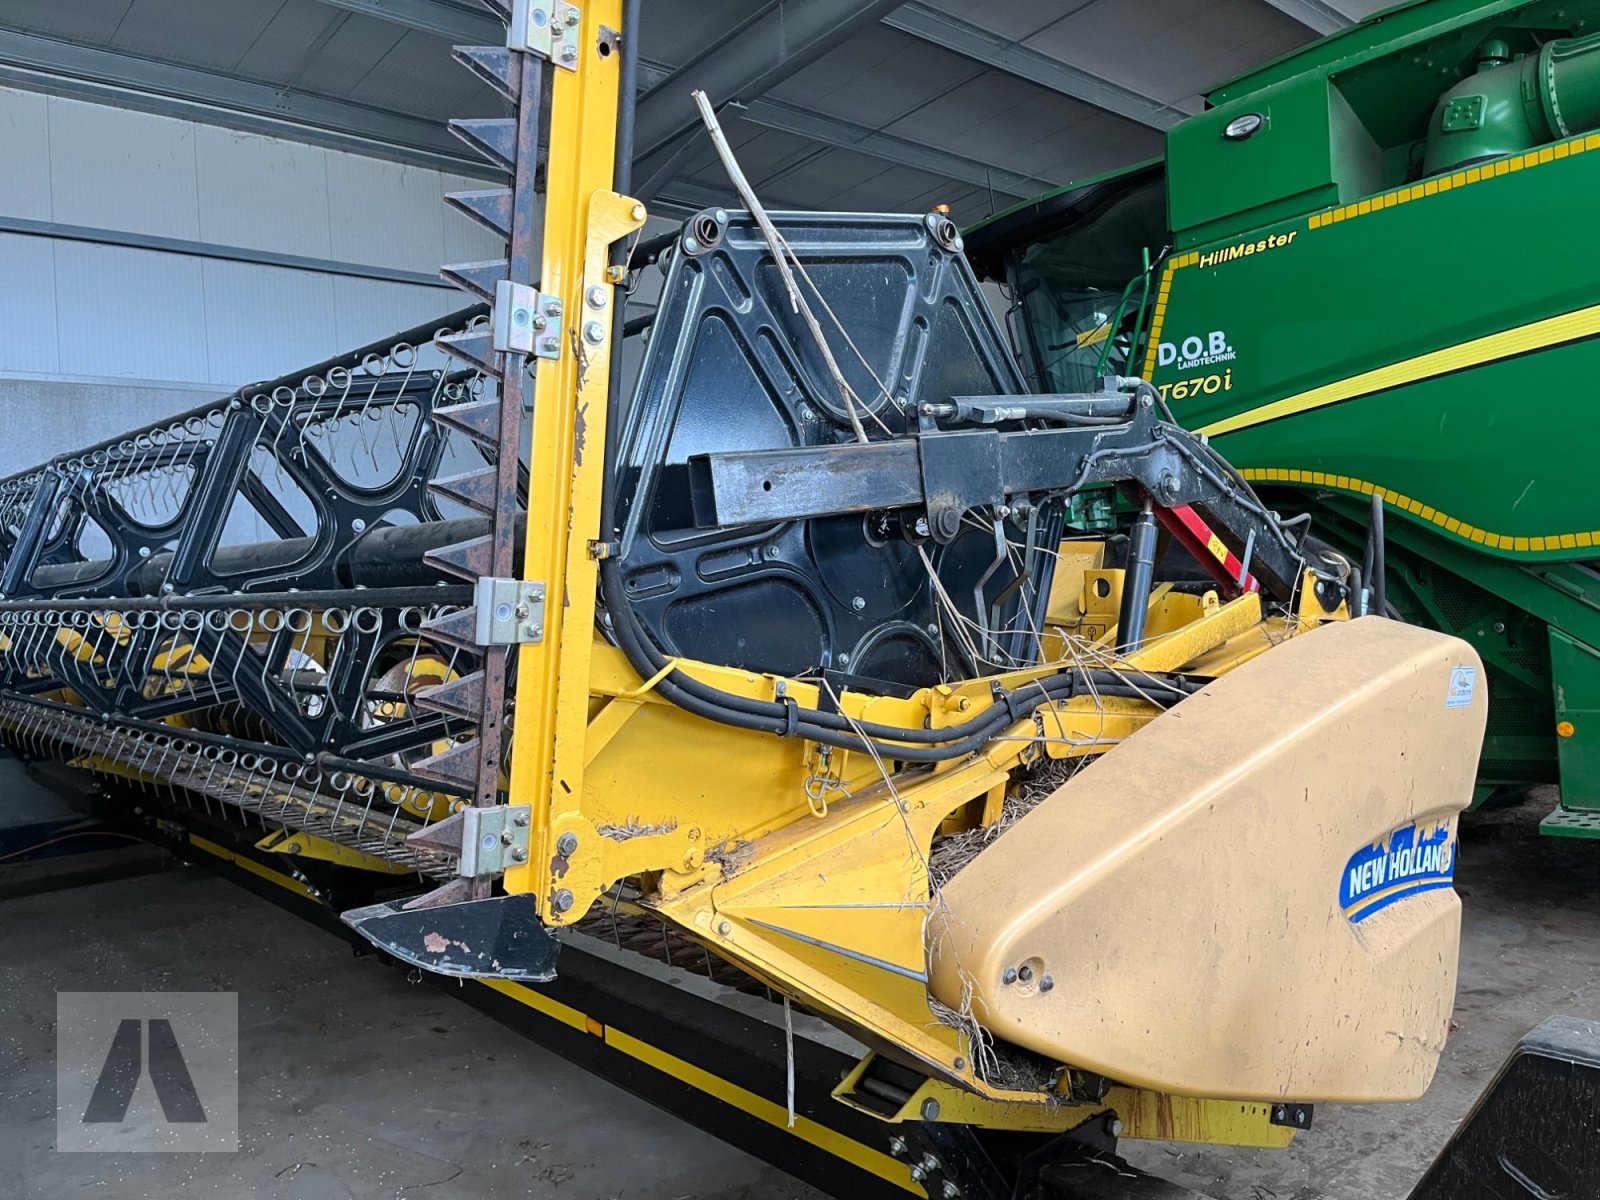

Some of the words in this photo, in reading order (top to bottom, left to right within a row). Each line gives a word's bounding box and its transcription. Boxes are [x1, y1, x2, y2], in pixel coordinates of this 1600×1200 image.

[1199, 231, 1297, 269] HillMaster
[1158, 330, 1233, 366] D.O.B.
[1177, 351, 1237, 370] LANDTECHNIK
[1159, 368, 1233, 401] T670i
[1349, 854, 1388, 899] NEW
